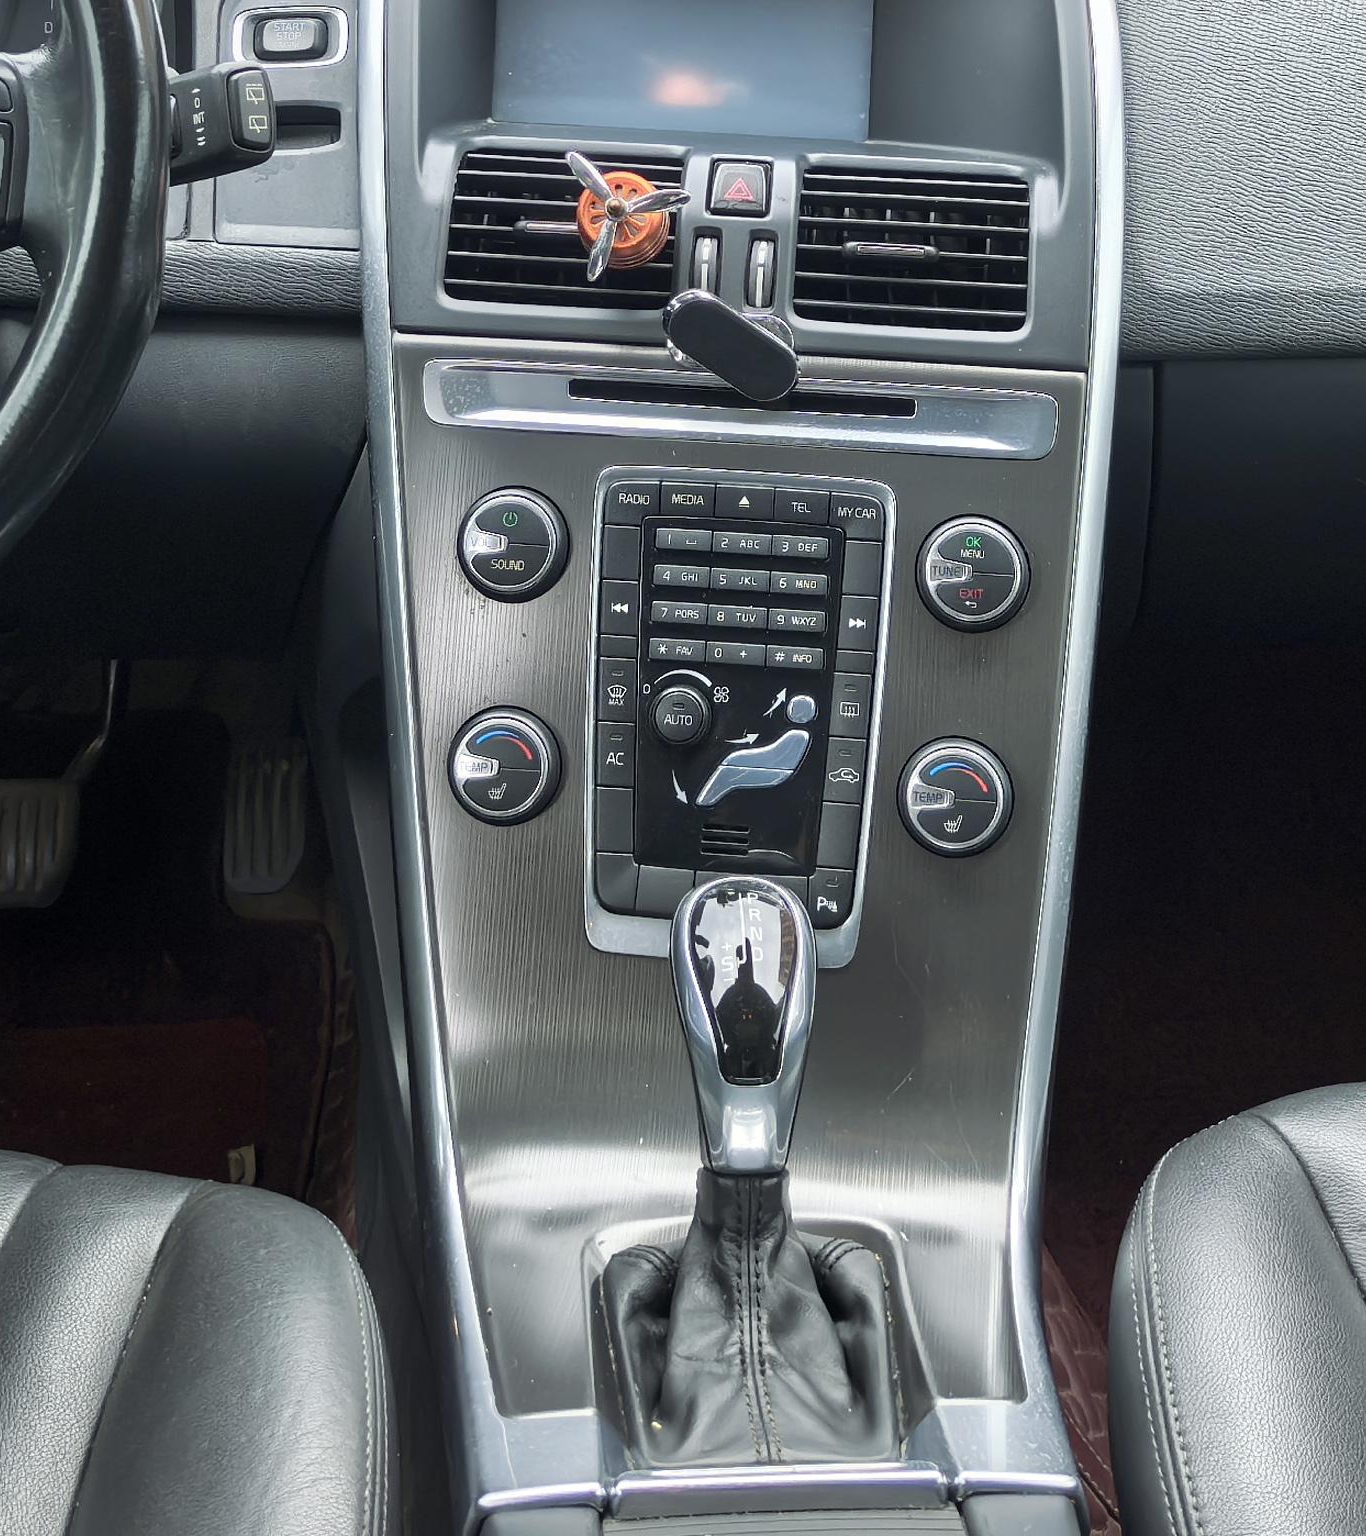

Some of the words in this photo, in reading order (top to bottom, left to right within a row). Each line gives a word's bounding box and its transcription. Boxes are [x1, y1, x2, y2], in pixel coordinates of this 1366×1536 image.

[273, 22, 306, 32] START
[277, 32, 302, 41] STOP
[618, 492, 651, 506] RADIO
[671, 493, 705, 506] MEDIA
[791, 502, 811, 514] TEL
[837, 506, 854, 518] MY
[855, 507, 877, 520] CAR
[721, 537, 729, 548] 2
[739, 539, 761, 550] ABC
[781, 541, 789, 552] 3
[797, 542, 819, 553] DEF
[965, 536, 983, 548] OK
[960, 548, 985, 559] MENU
[490, 558, 525, 571] SOUND
[662, 570, 671, 581] 4
[681, 571, 699, 582] GHI
[931, 565, 961, 577] TUNE
[719, 574, 727, 585] 5
[739, 576, 757, 586] JKL
[779, 578, 787, 588] 6
[795, 579, 817, 590] MNO
[959, 588, 983, 599] EXIT
[661, 607, 667, 618] 7
[675, 609, 699, 620] PQRS
[717, 611, 725, 622] 8
[735, 612, 757, 623] TUV
[777, 614, 785, 625] 9
[791, 616, 817, 626] WXYZ
[675, 646, 693, 656] FAV
[792, 654, 813, 664] INFO
[608, 698, 625, 706] MAX
[663, 714, 693, 726] AUTO
[605, 752, 625, 766] AC
[913, 791, 943, 804] TEMP
[749, 909, 761, 922] R
